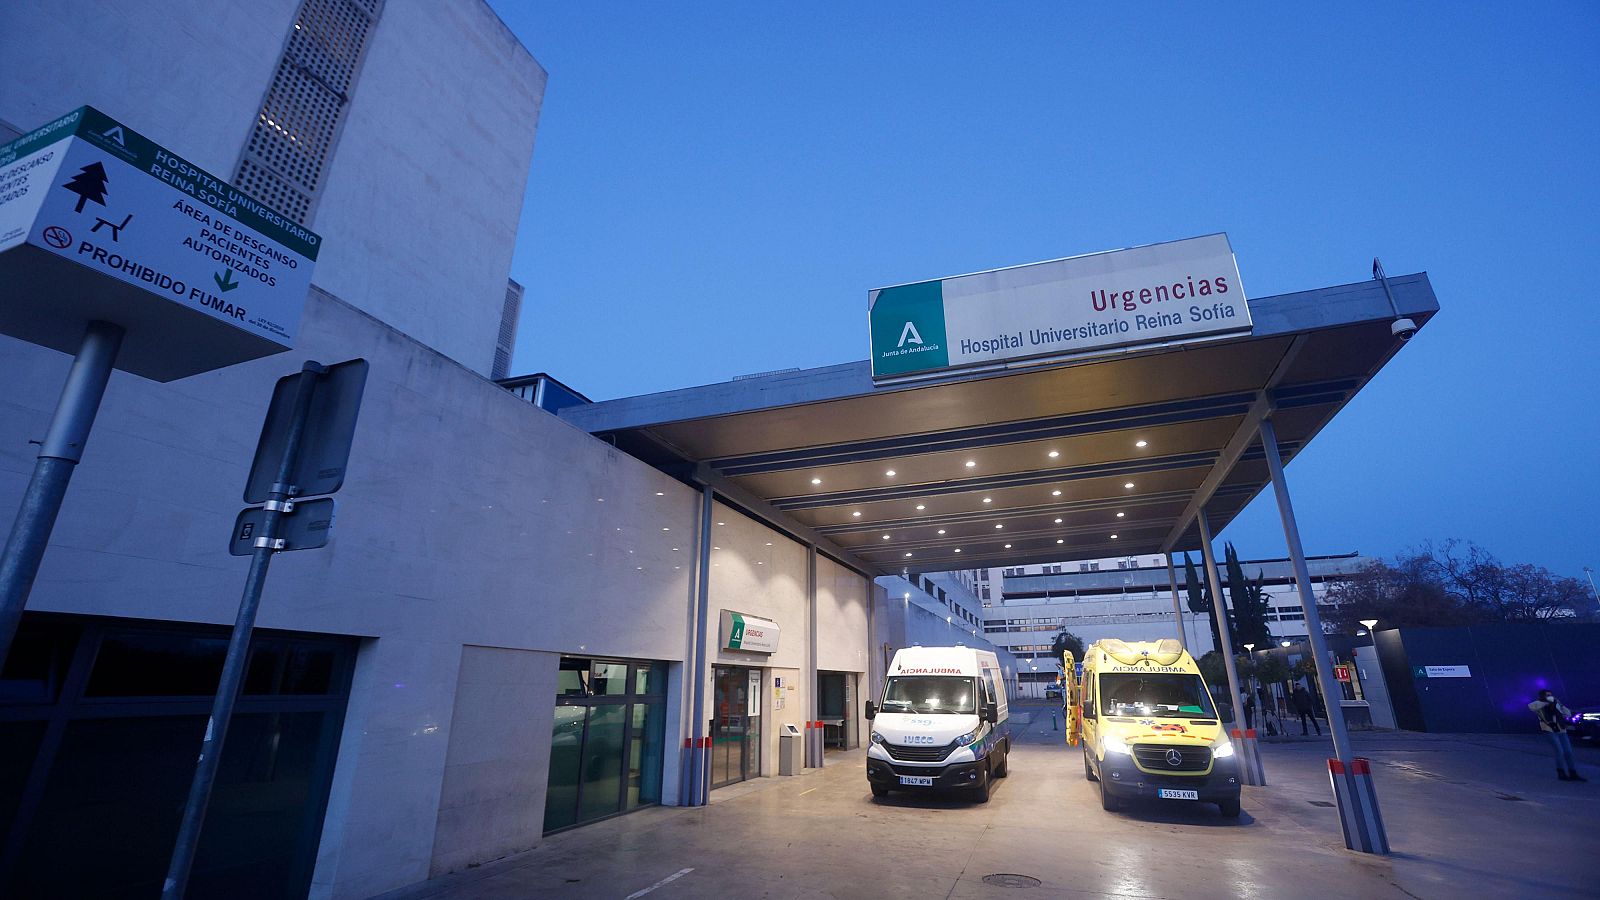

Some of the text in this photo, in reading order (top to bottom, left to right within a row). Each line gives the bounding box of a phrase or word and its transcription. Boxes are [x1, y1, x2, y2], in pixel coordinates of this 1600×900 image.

[14, 112, 79, 149] UNIVERSITARIO
[7, 151, 54, 179] DESCANSO
[150, 164, 237, 217] REINA SOFÍA
[155, 150, 317, 245] HOSPITAL UNIVERSITARIO
[173, 199, 298, 269] ÁREA DE DESCANSO
[200, 228, 270, 270] PACIENTES
[78, 241, 246, 321] PROHIBIDO FUMAR
[182, 237, 276, 287] AUTORIZADOS
[1091, 275, 1228, 312] Urgencias
[882, 350, 900, 358] Junta
[909, 344, 939, 354] Andalucía
[960, 303, 1235, 354] Hospital Universitario Reina Sofía
[904, 735, 935, 744] IVECO
